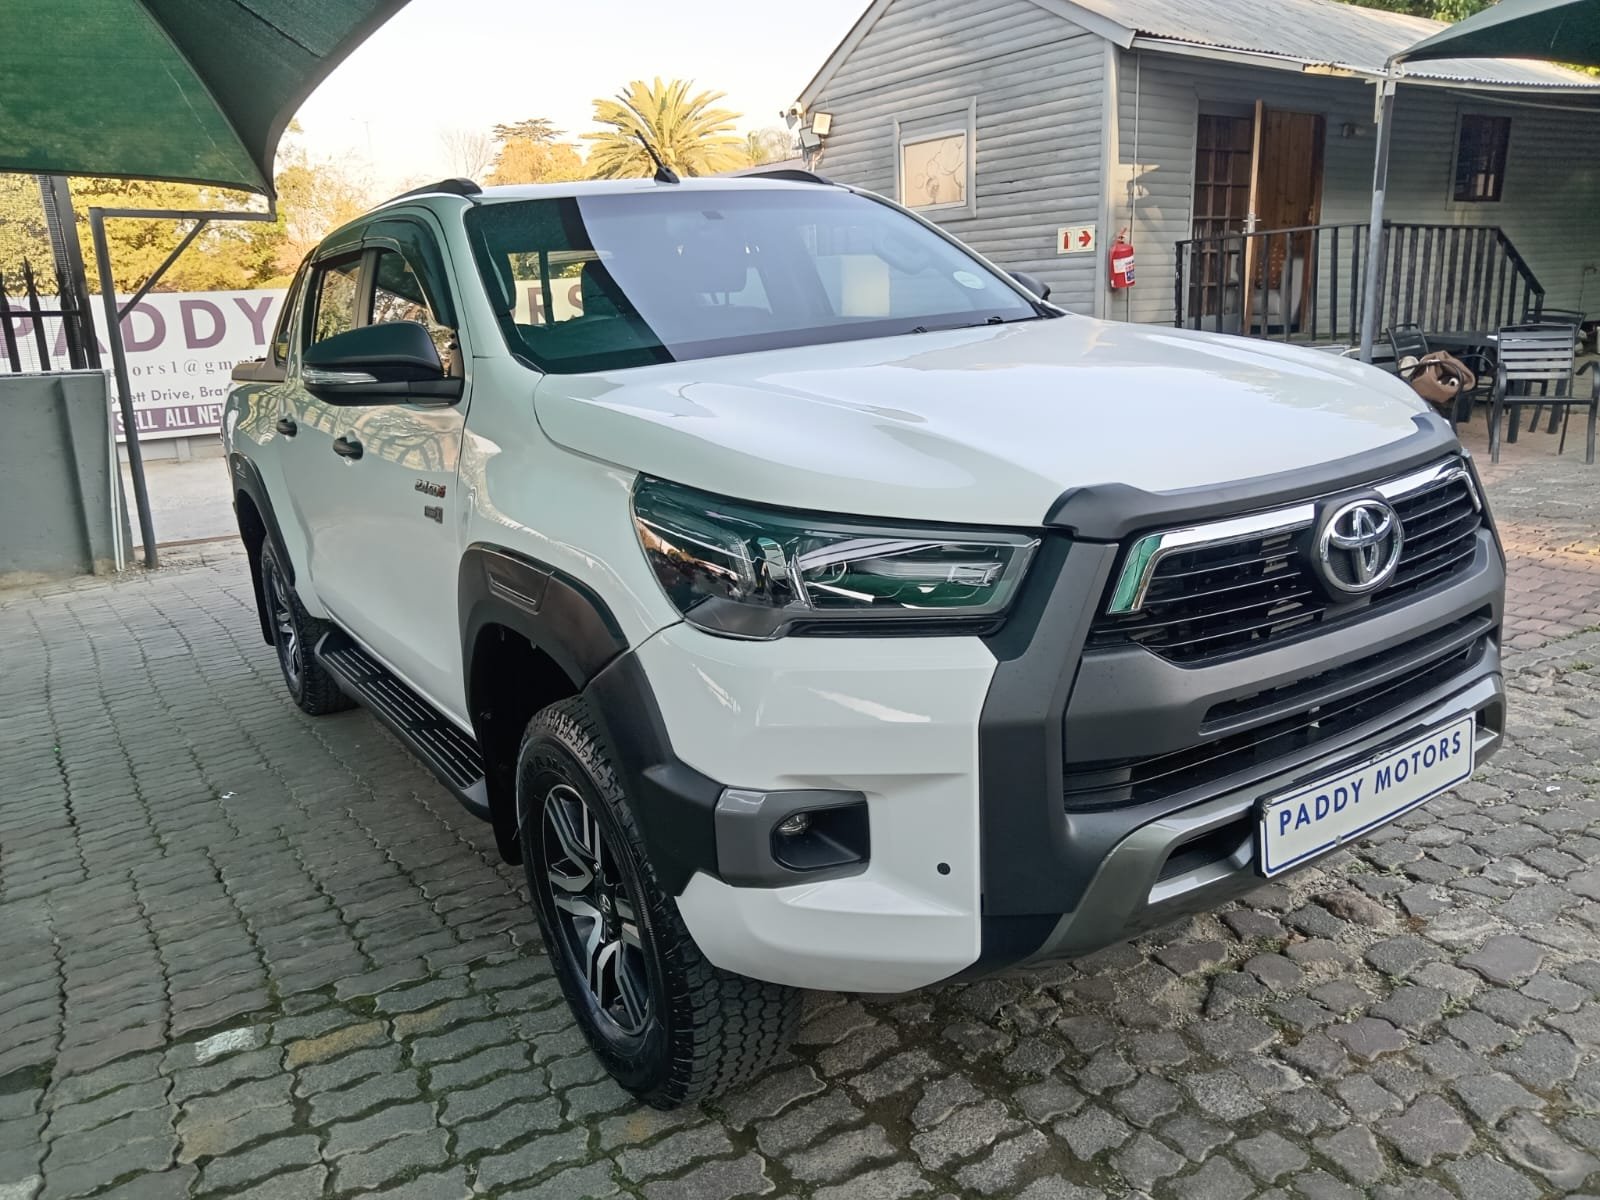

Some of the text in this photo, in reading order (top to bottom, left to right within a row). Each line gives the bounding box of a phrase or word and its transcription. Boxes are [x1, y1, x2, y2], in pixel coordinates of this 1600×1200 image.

[151, 387, 195, 401] Drive,
[165, 407, 196, 428] ALL
[1279, 730, 1462, 837] PADDY MOTORS
